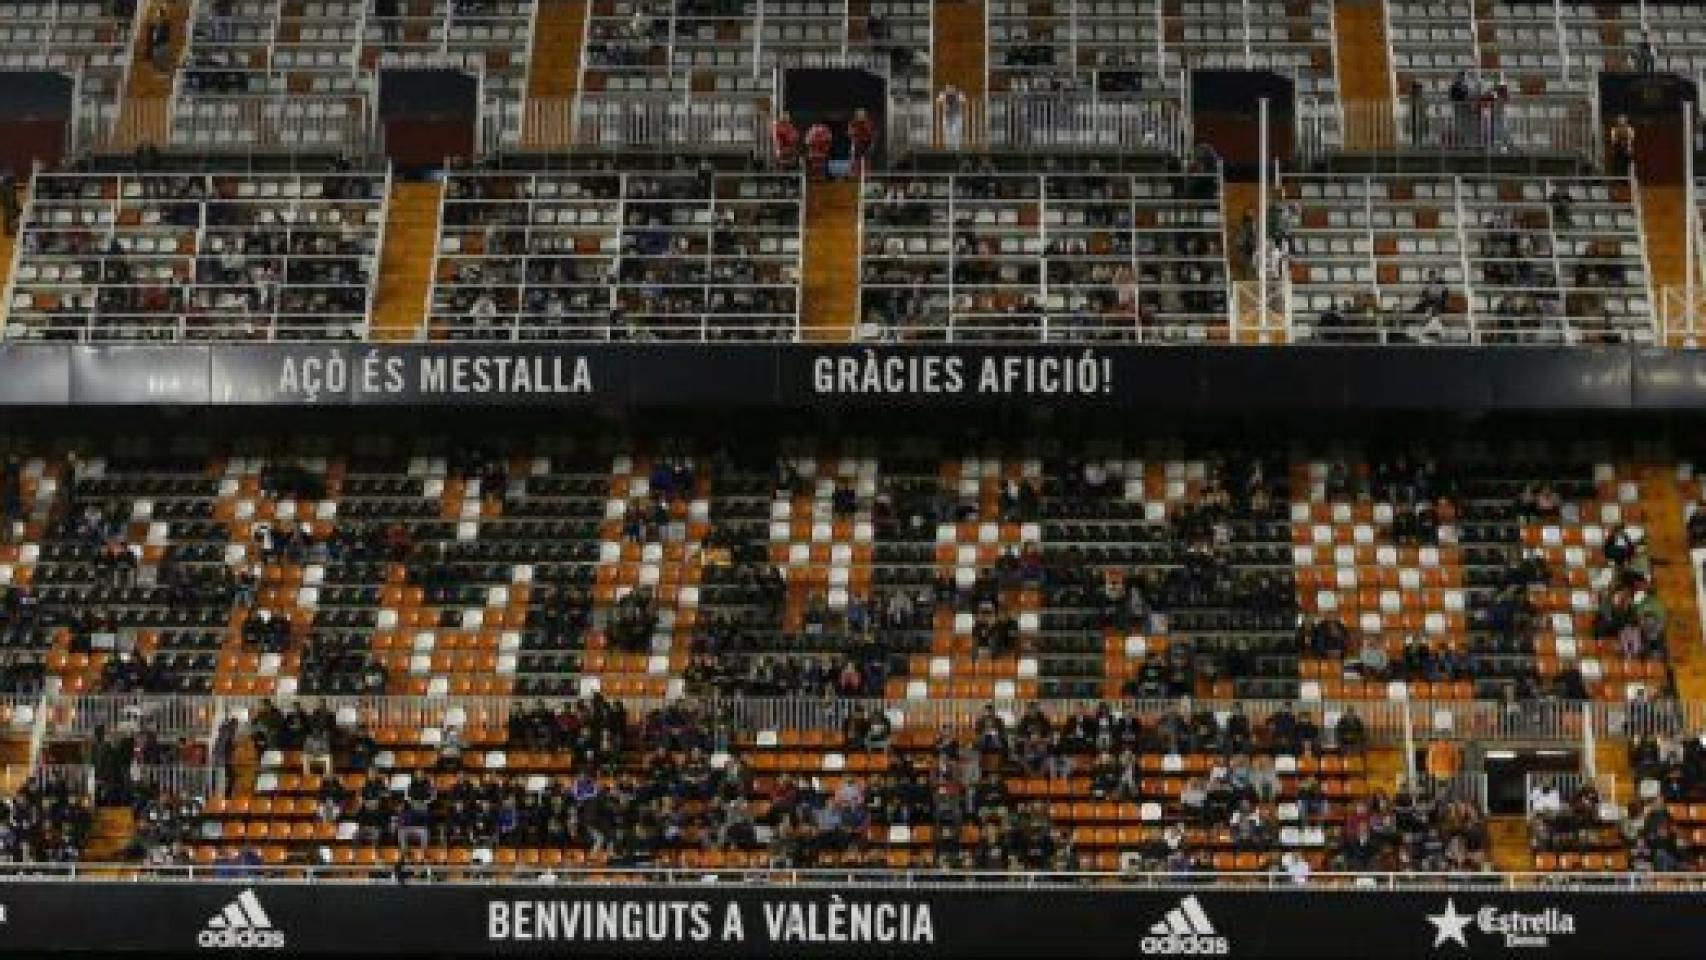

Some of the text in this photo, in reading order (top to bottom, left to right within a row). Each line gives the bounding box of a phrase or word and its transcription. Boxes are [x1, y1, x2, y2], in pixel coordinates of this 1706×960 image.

[280, 350, 592, 401] AÇÒ ÉS MESTALLA
[814, 349, 1112, 393] GRÀCIES AFICIÓ!
[198, 928, 285, 948] adidas
[488, 894, 934, 941] BENVINGUTS A VALÈNCIA
[1140, 933, 1230, 955] adidas
